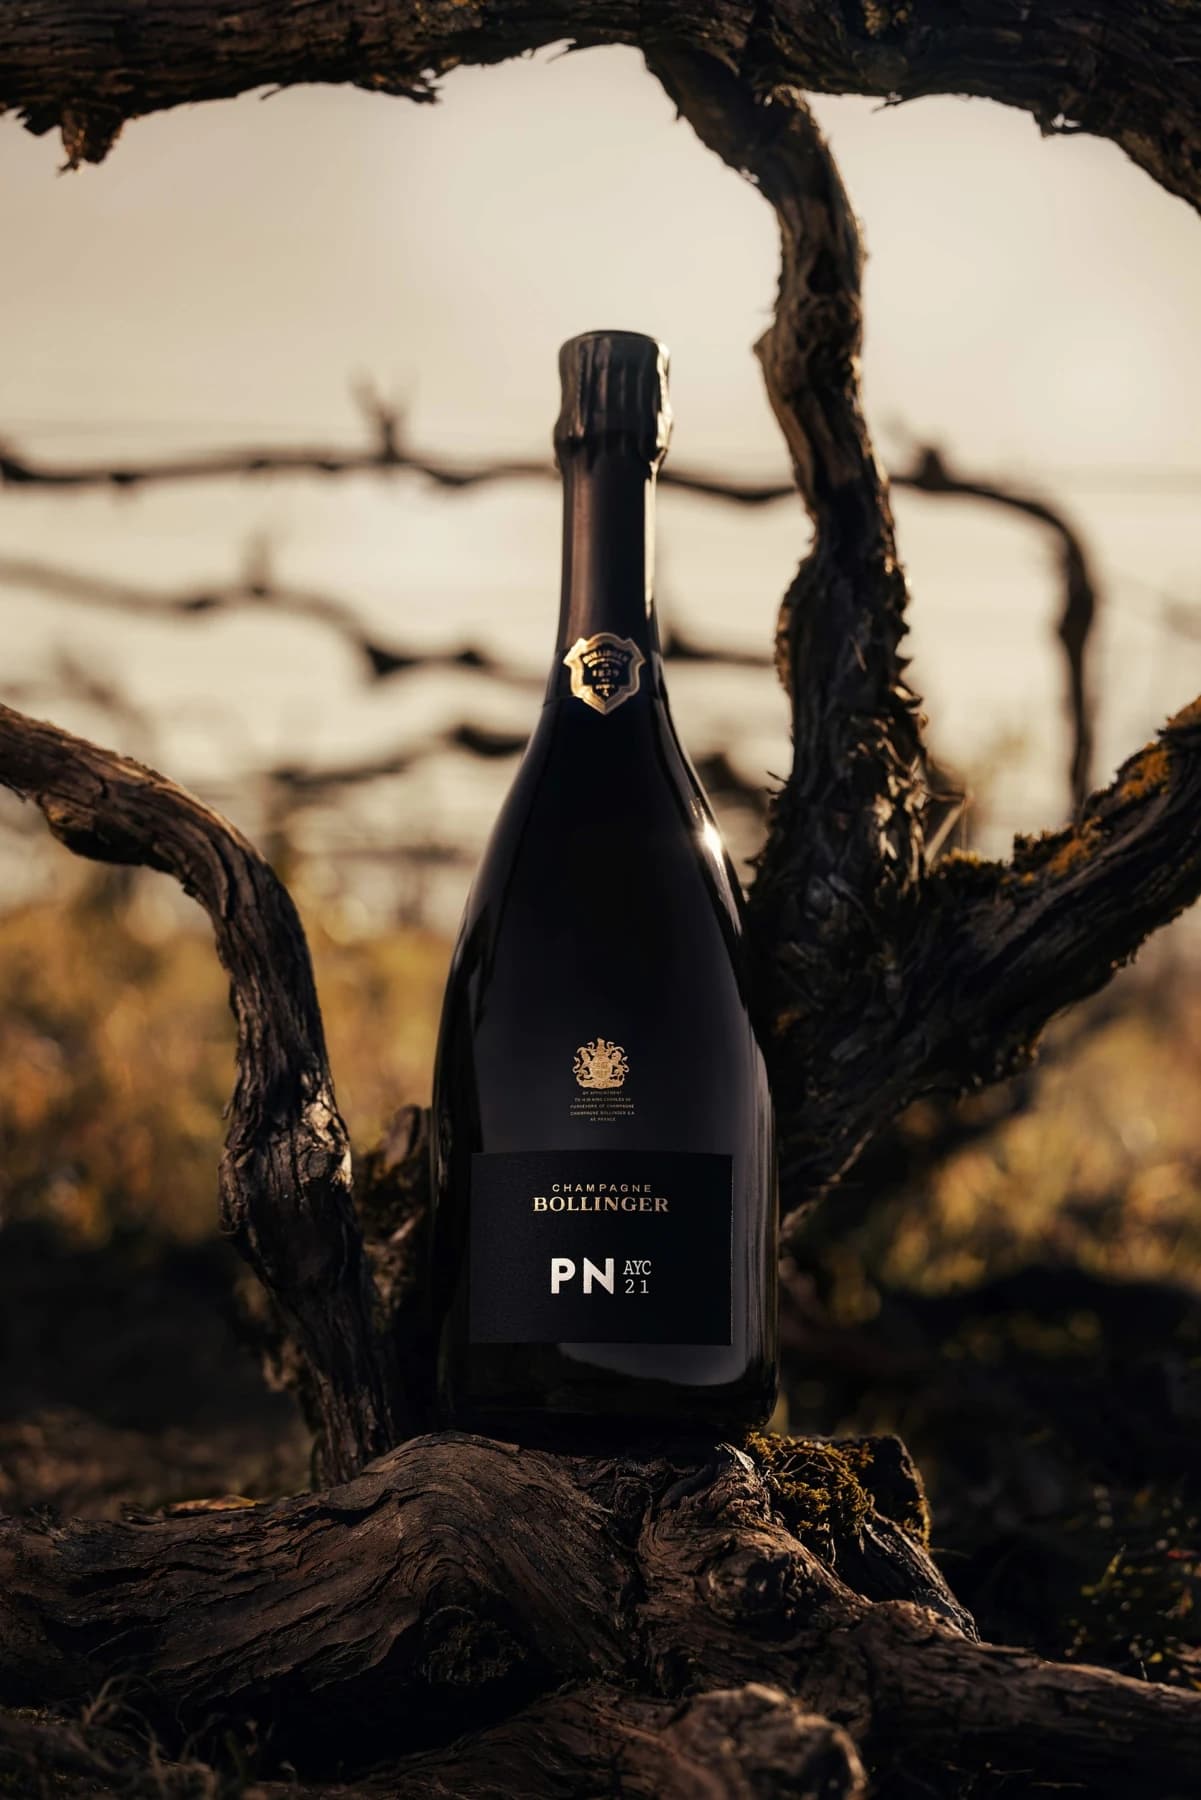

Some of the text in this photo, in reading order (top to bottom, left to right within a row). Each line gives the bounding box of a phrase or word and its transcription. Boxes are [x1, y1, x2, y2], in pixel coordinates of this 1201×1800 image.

[552, 1183, 652, 1192] CHAMPAGNE
[532, 1196, 669, 1212] BOLLINGER
[551, 1257, 652, 1295] PN AYC
[624, 1278, 650, 1294] 21
